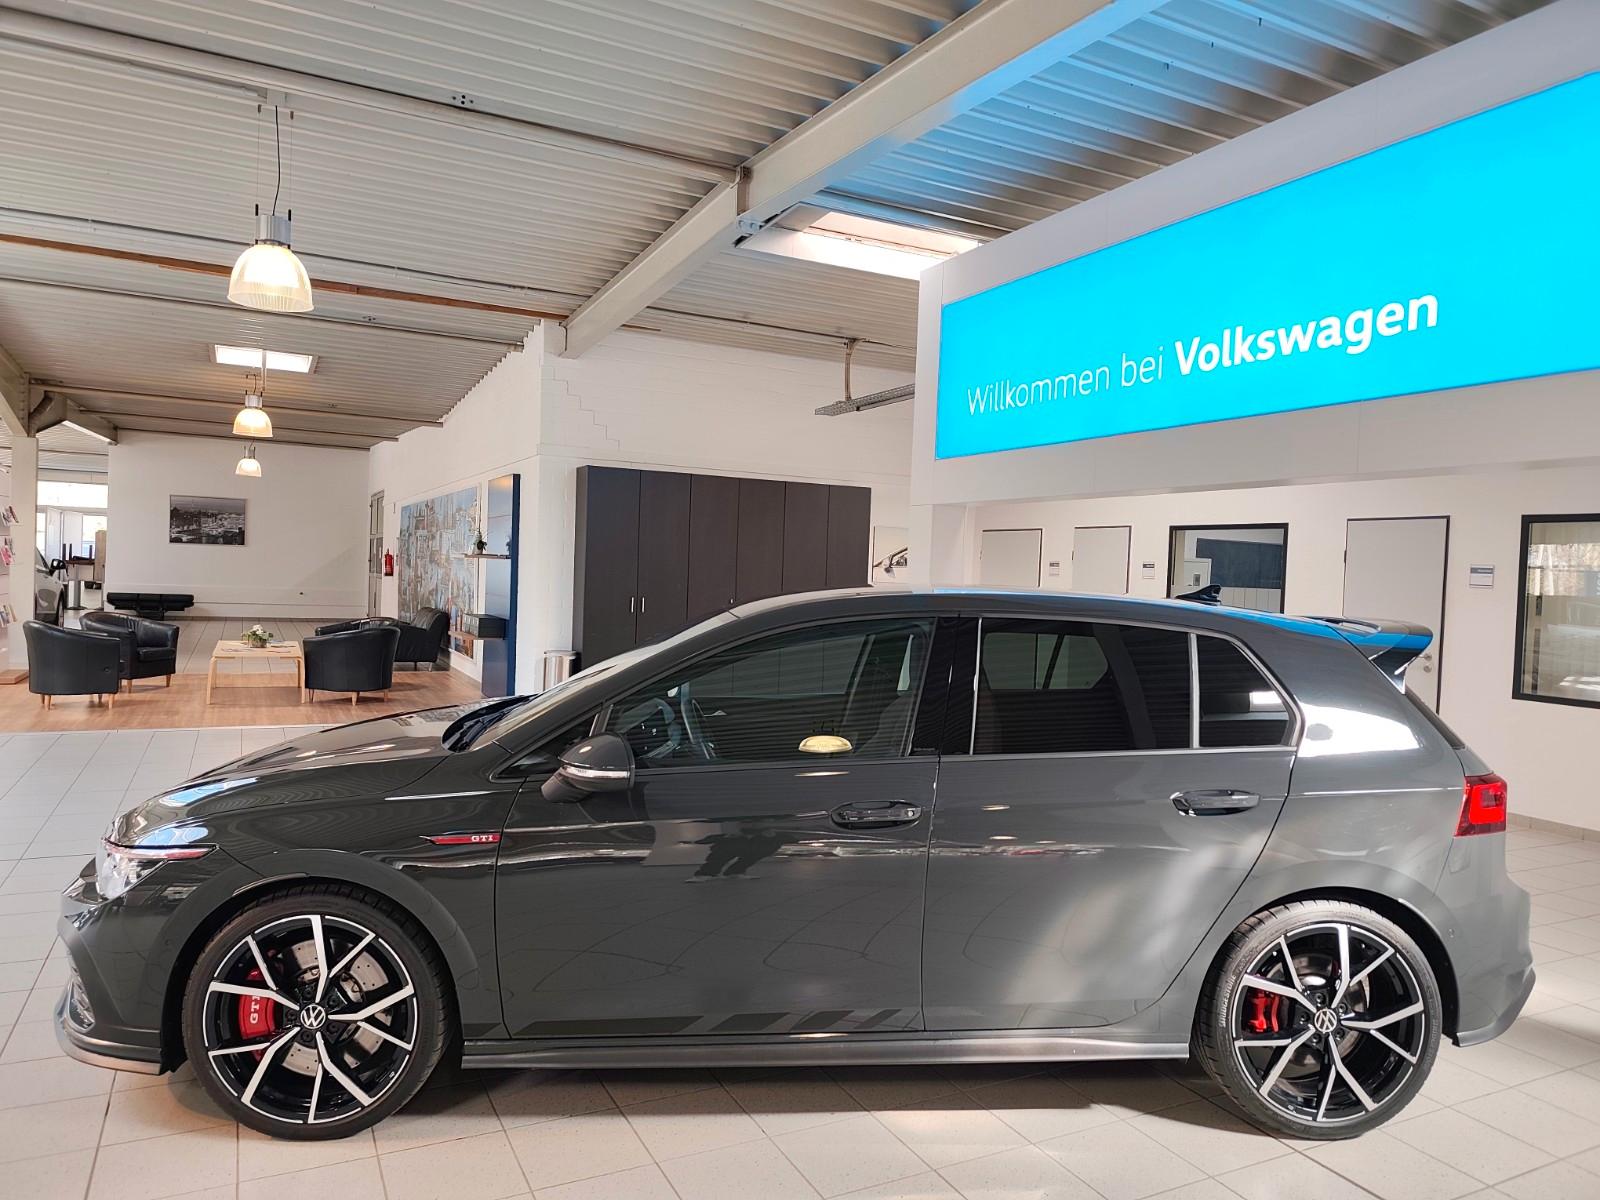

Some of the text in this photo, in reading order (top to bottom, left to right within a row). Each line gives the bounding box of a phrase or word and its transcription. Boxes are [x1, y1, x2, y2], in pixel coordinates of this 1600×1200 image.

[966, 293, 1439, 416] Willkommen bei Volkswagen
[471, 834, 494, 842] GTI
